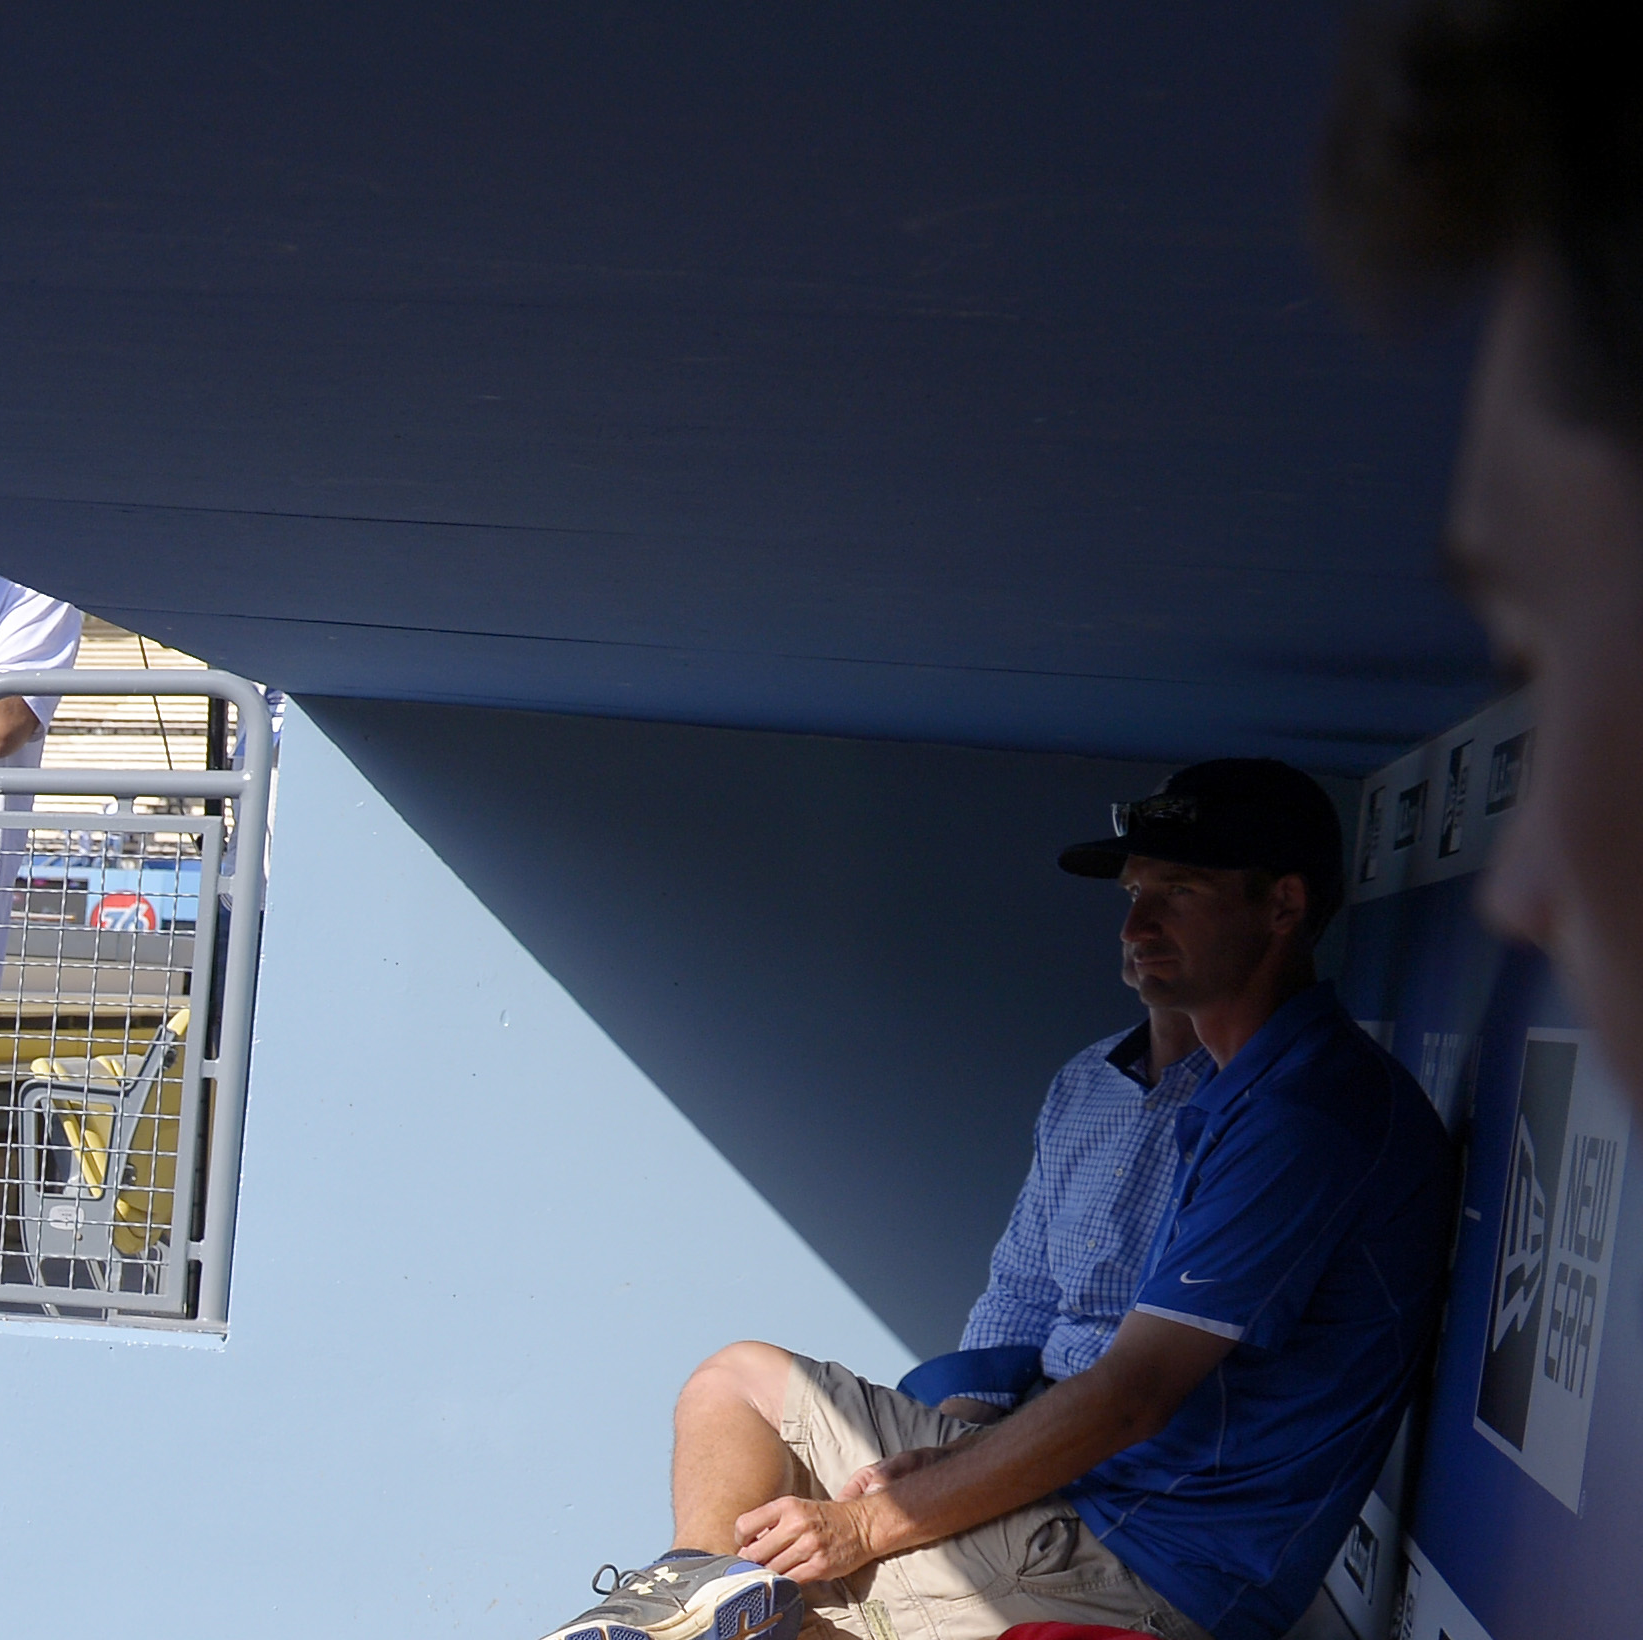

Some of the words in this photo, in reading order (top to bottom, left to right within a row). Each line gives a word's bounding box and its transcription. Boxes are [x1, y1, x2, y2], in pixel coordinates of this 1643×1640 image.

[101, 902, 150, 931] 76
[1559, 1133, 1617, 1263] NEW
[1543, 1262, 1600, 1399] ERA
